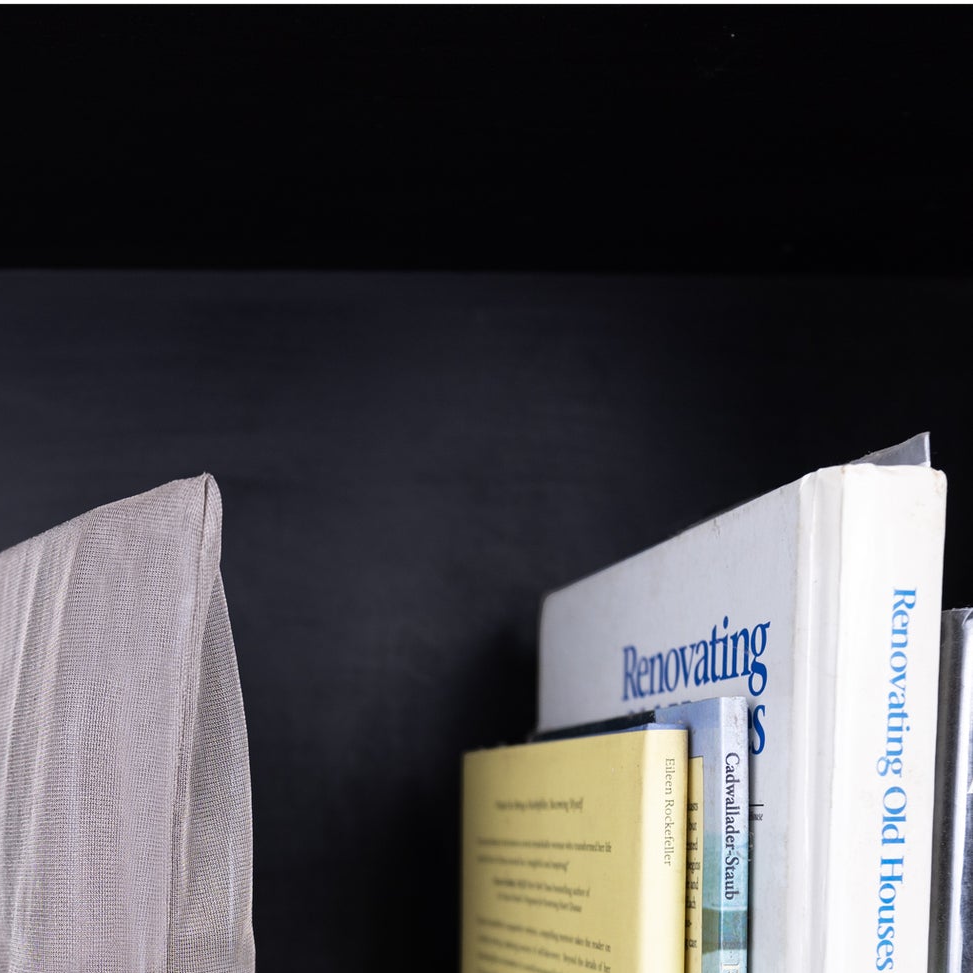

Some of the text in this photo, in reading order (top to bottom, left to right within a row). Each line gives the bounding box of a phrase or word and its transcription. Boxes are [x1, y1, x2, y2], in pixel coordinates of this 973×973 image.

[621, 616, 771, 701] Renovating
[663, 757, 676, 867] Eileen Rockefeller
[724, 752, 741, 901] Cadwallader-Staub
[875, 587, 917, 971] Renovating Old Houses
